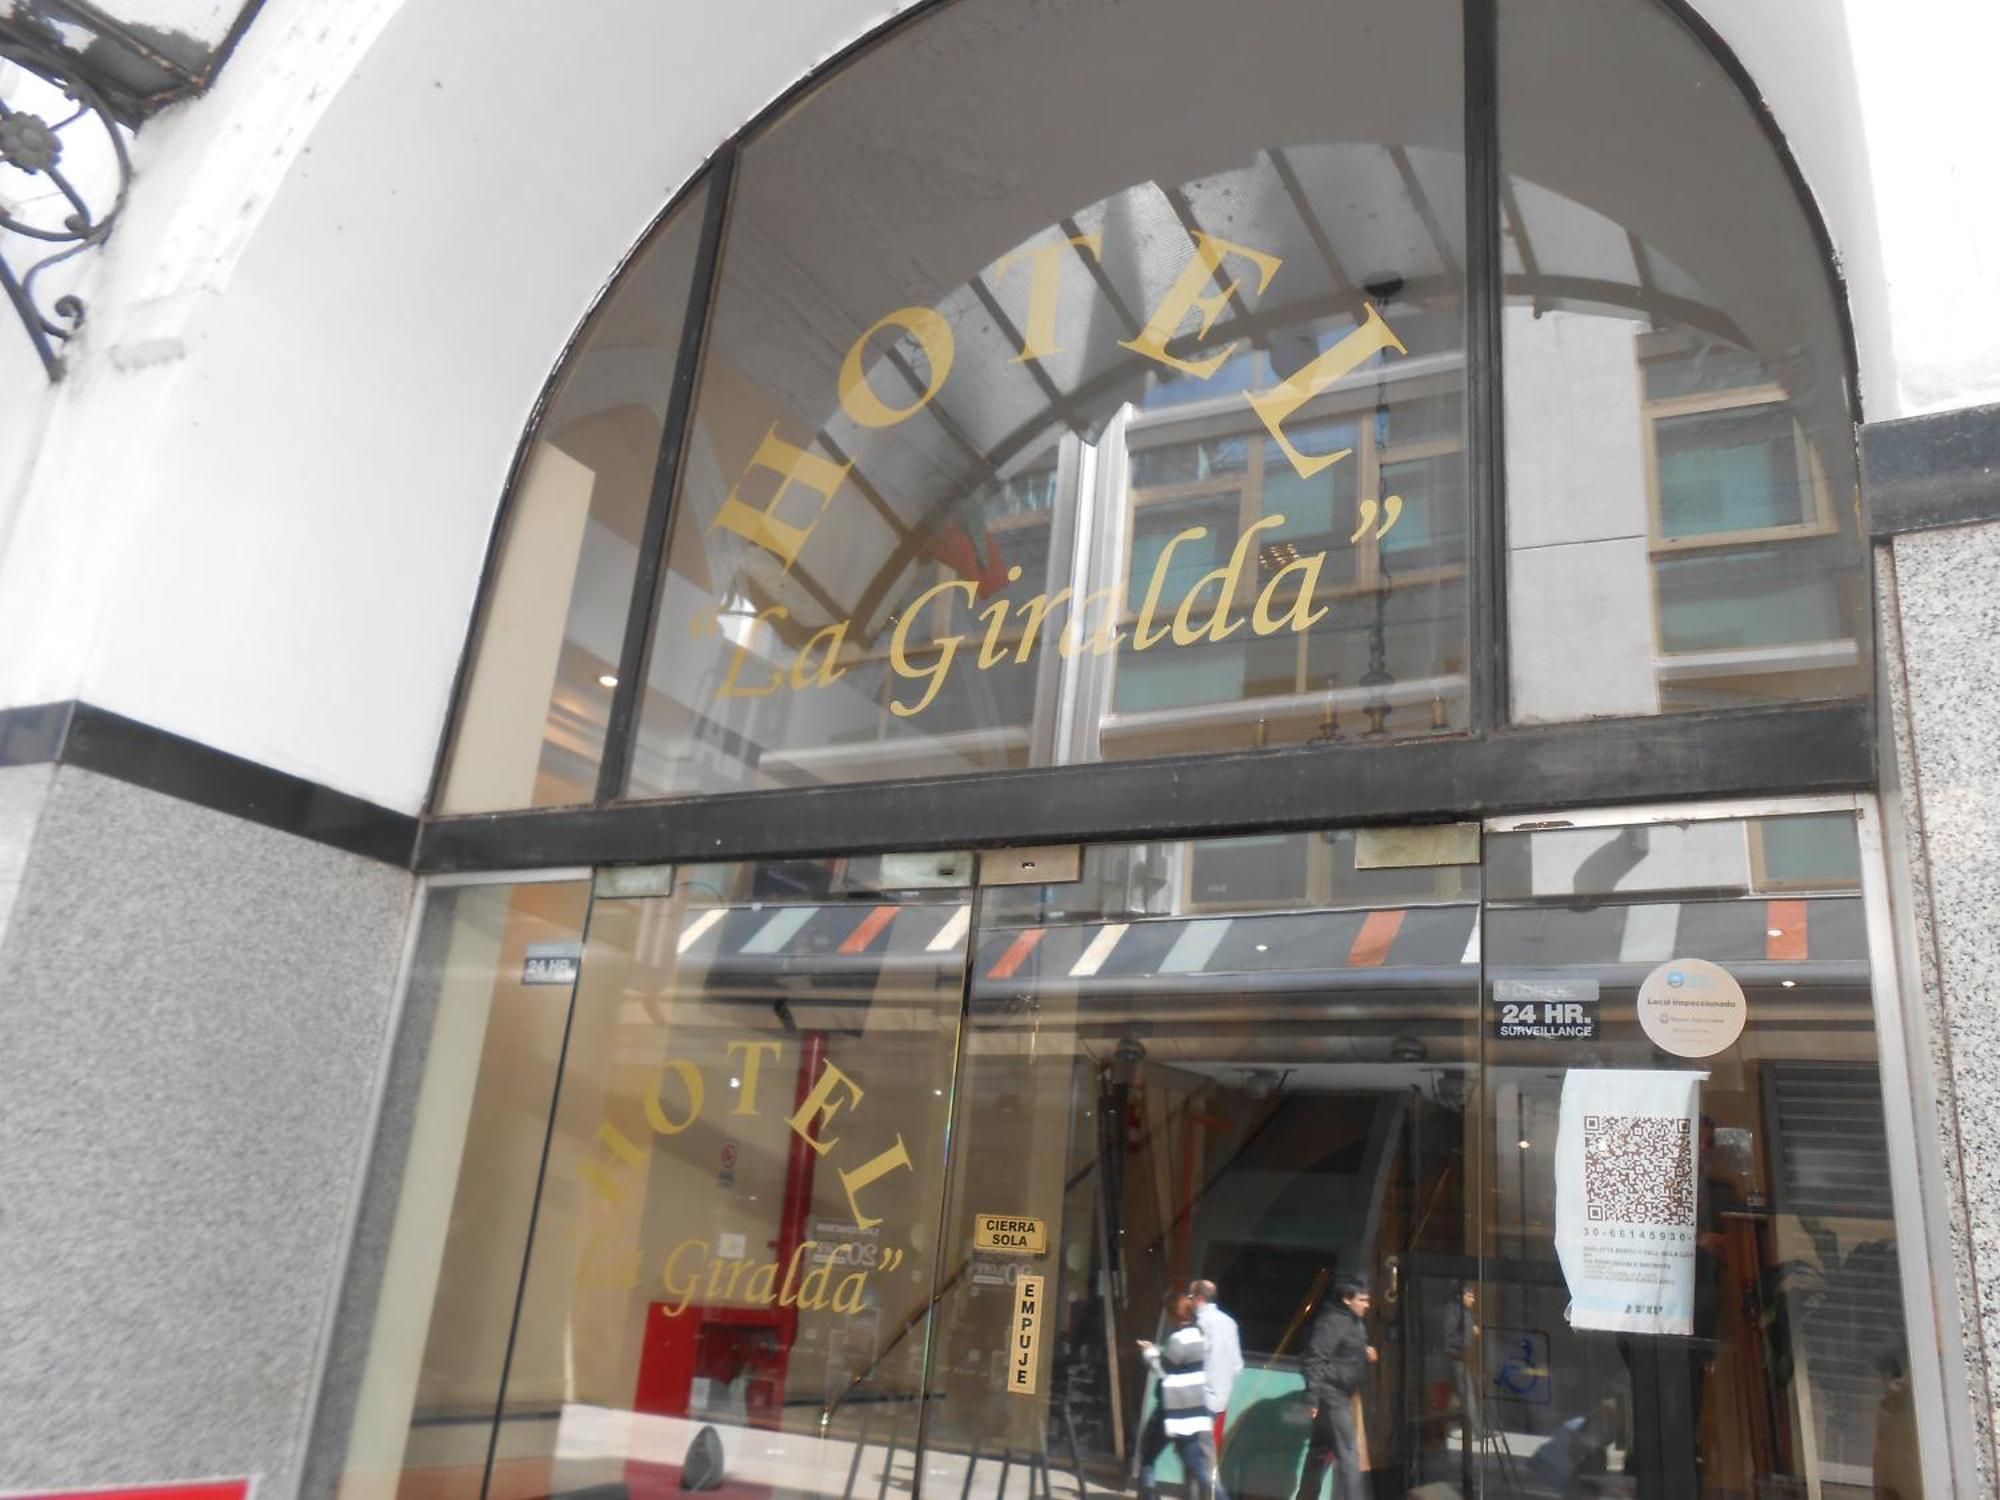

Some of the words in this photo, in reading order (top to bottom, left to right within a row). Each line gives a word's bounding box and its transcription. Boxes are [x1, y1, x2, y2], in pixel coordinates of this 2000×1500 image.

[706, 230, 1408, 577] HOTEL
[889, 494, 1403, 717] Giralda”
[1500, 1025, 1593, 1037] SURVEILLANCE
[1502, 1003, 1537, 1024] 24
[1544, 1003, 1592, 1024] HR.
[576, 1039, 914, 1231] HOTEL
[986, 1219, 1036, 1233] CIERRA
[992, 1233, 1028, 1247] SOLA
[1016, 1283, 1036, 1385] EMPUJE
